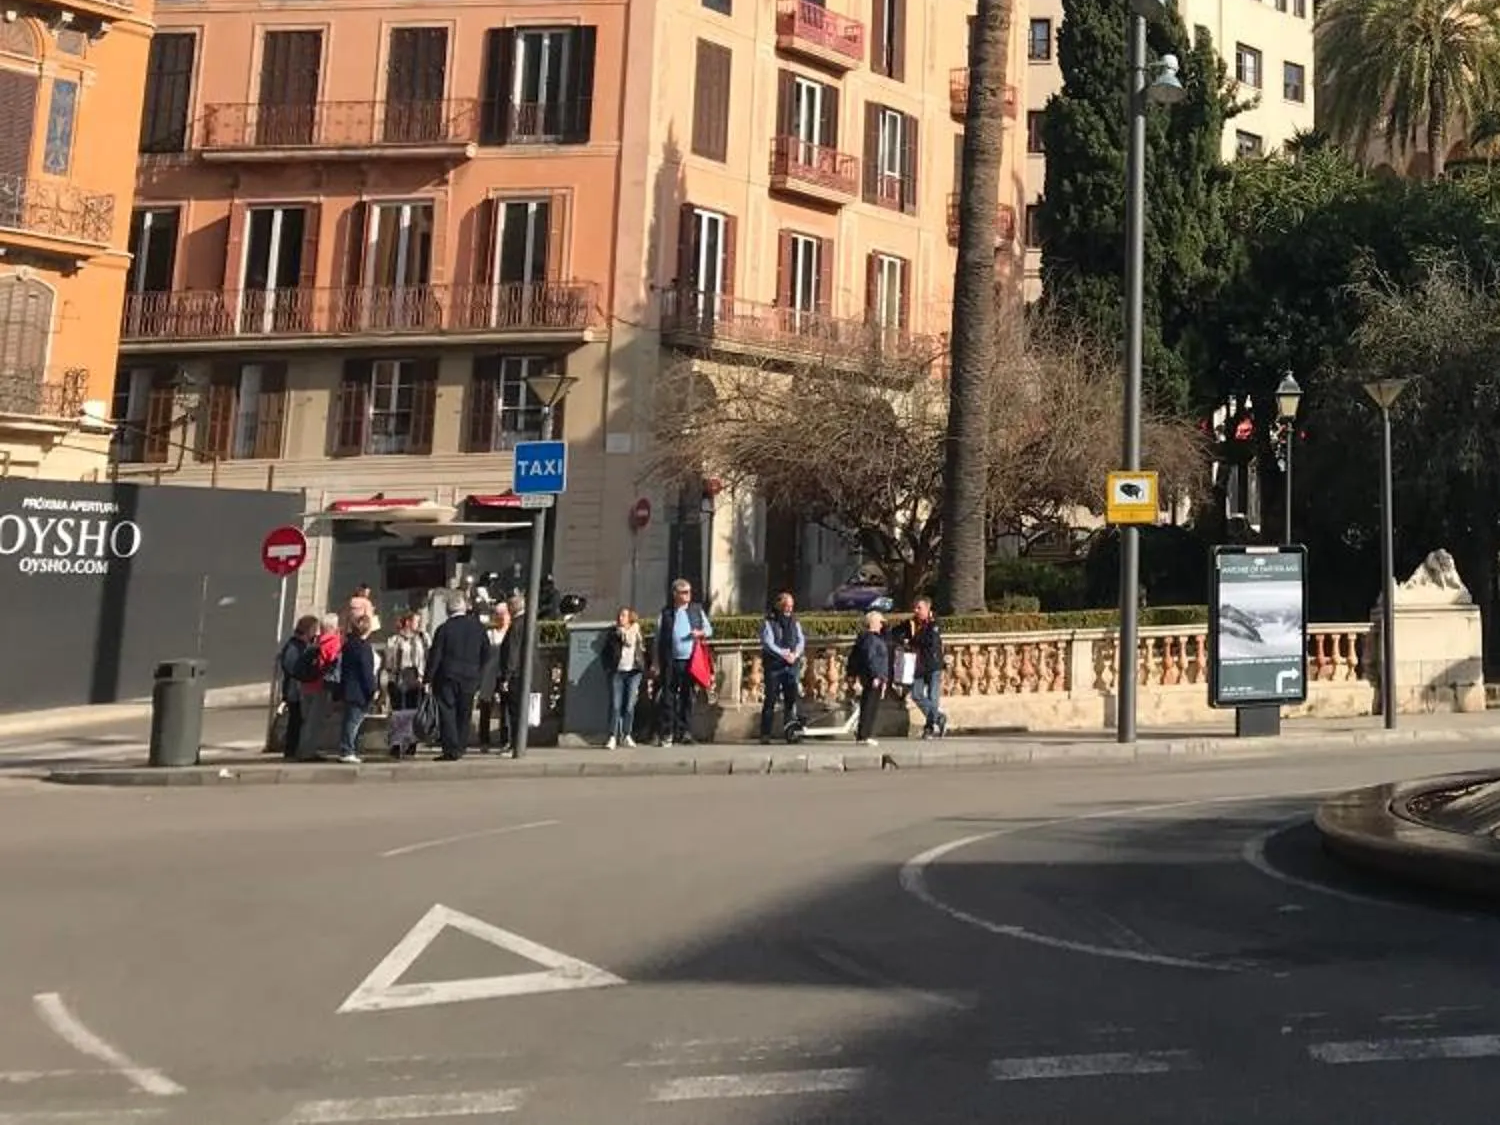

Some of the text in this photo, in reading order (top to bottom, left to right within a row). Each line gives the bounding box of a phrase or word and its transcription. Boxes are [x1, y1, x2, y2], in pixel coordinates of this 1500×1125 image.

[517, 459, 563, 476] TAXI
[0, 514, 141, 558] OYSHO
[19, 556, 109, 575] OYSHO.COM
